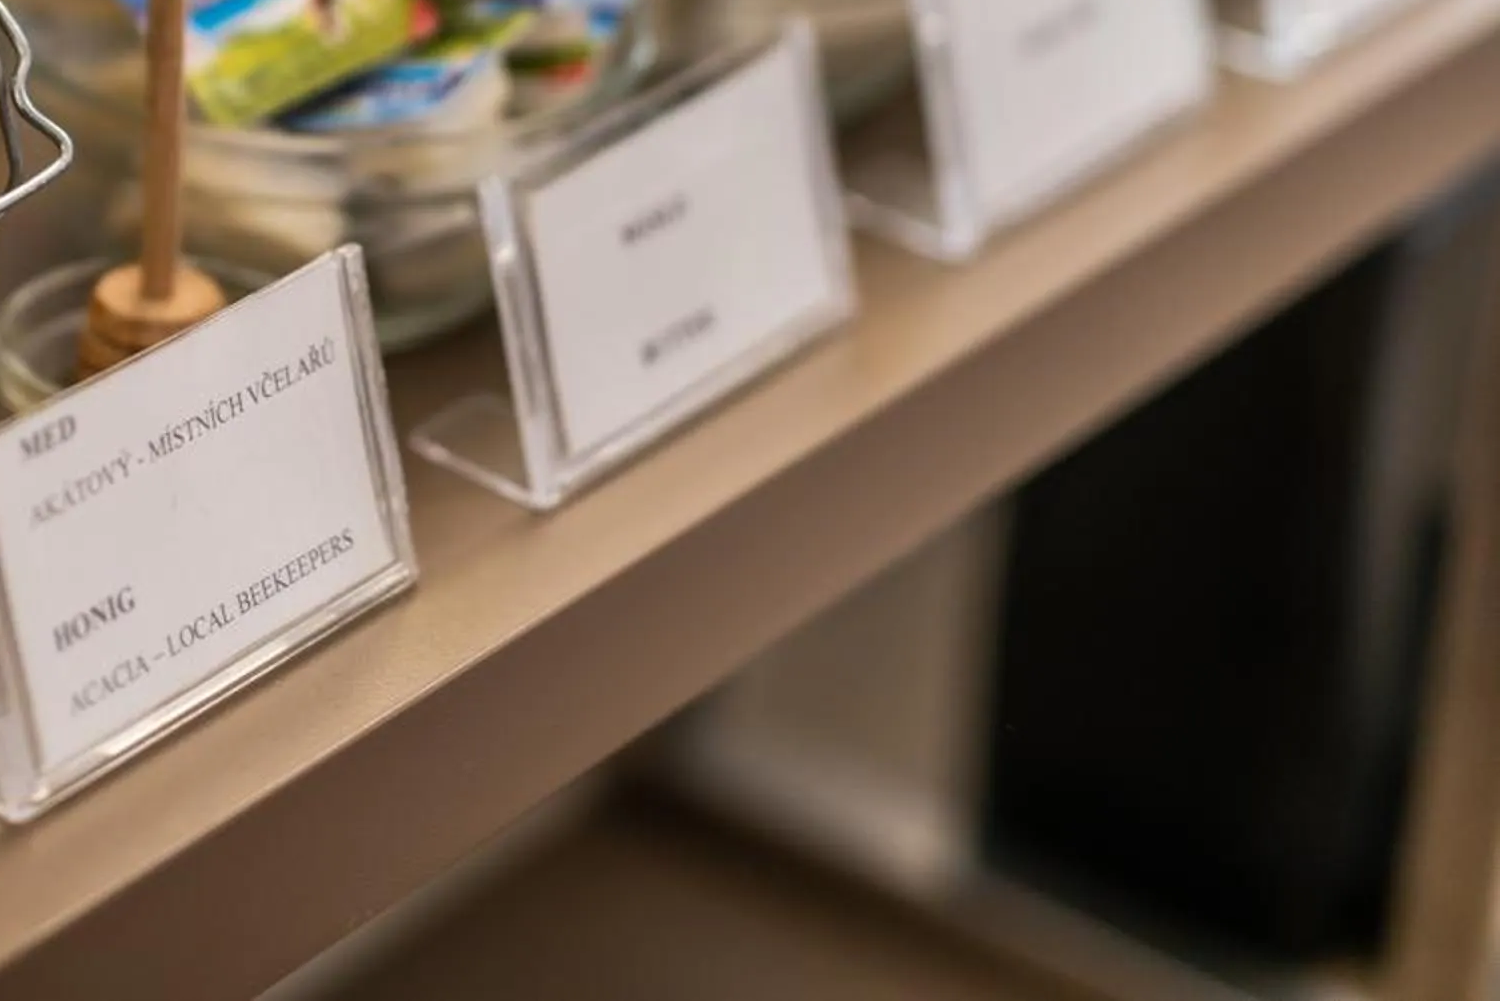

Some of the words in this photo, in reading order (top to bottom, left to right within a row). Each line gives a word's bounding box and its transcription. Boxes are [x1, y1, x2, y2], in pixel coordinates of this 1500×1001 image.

[18, 414, 77, 463] MED
[30, 448, 134, 530] AKÁTOVÝ
[147, 400, 244, 460] MÍSTNÍCH
[245, 336, 336, 405] VČELAŘŮ
[52, 584, 136, 652] HONIG
[70, 655, 150, 717] ACACIA
[165, 602, 235, 658] LOCAL
[235, 527, 355, 615] BEEKEEPERS
